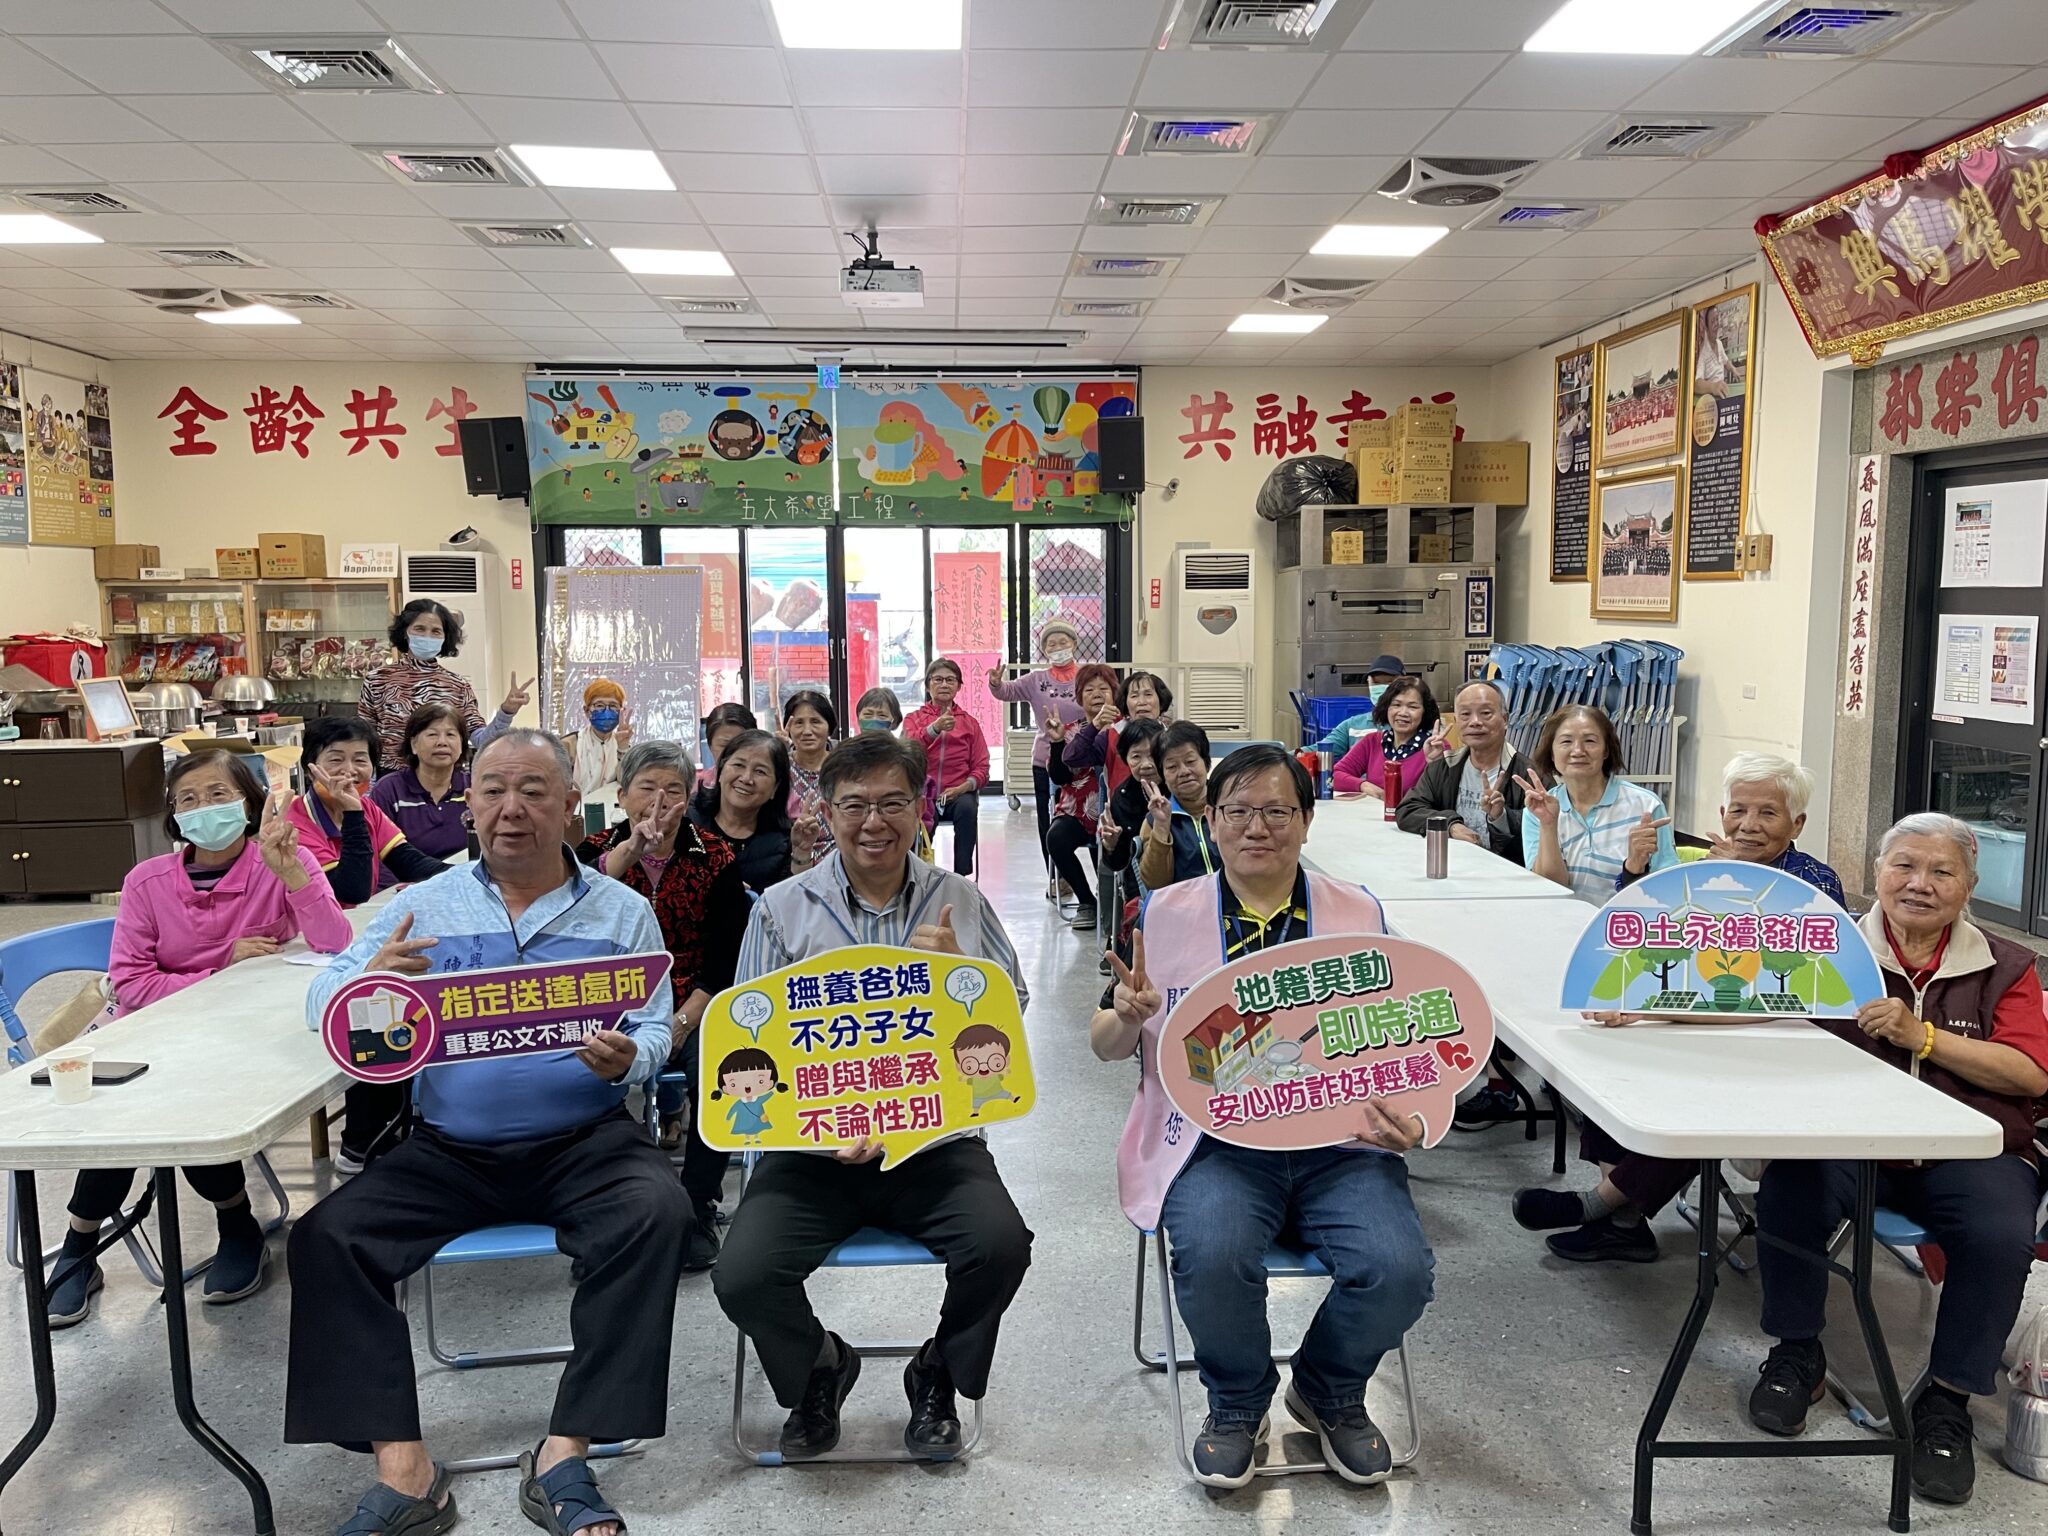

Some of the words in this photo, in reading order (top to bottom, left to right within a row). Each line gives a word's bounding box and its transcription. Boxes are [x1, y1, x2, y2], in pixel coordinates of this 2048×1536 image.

[157, 385, 478, 459] 全齡共生
[1178, 390, 1465, 462] 共融幸
[33, 475, 47, 487] 07
[344, 565, 394, 574] Happiness
[1605, 911, 1840, 954] 國土永續發展
[438, 966, 647, 1021] 指定送達處所
[786, 962, 931, 1011] 撫養爸媽
[1234, 949, 1392, 1014] 地籍異動
[444, 1019, 604, 1056] 重要公文不漏收
[789, 1006, 935, 1053] 不分子女
[1317, 988, 1462, 1058] 即時通
[796, 1051, 941, 1100] 贈與繼承
[1208, 1053, 1440, 1129] 安心防詐好輕鬆
[798, 1094, 944, 1143] 不論性別
